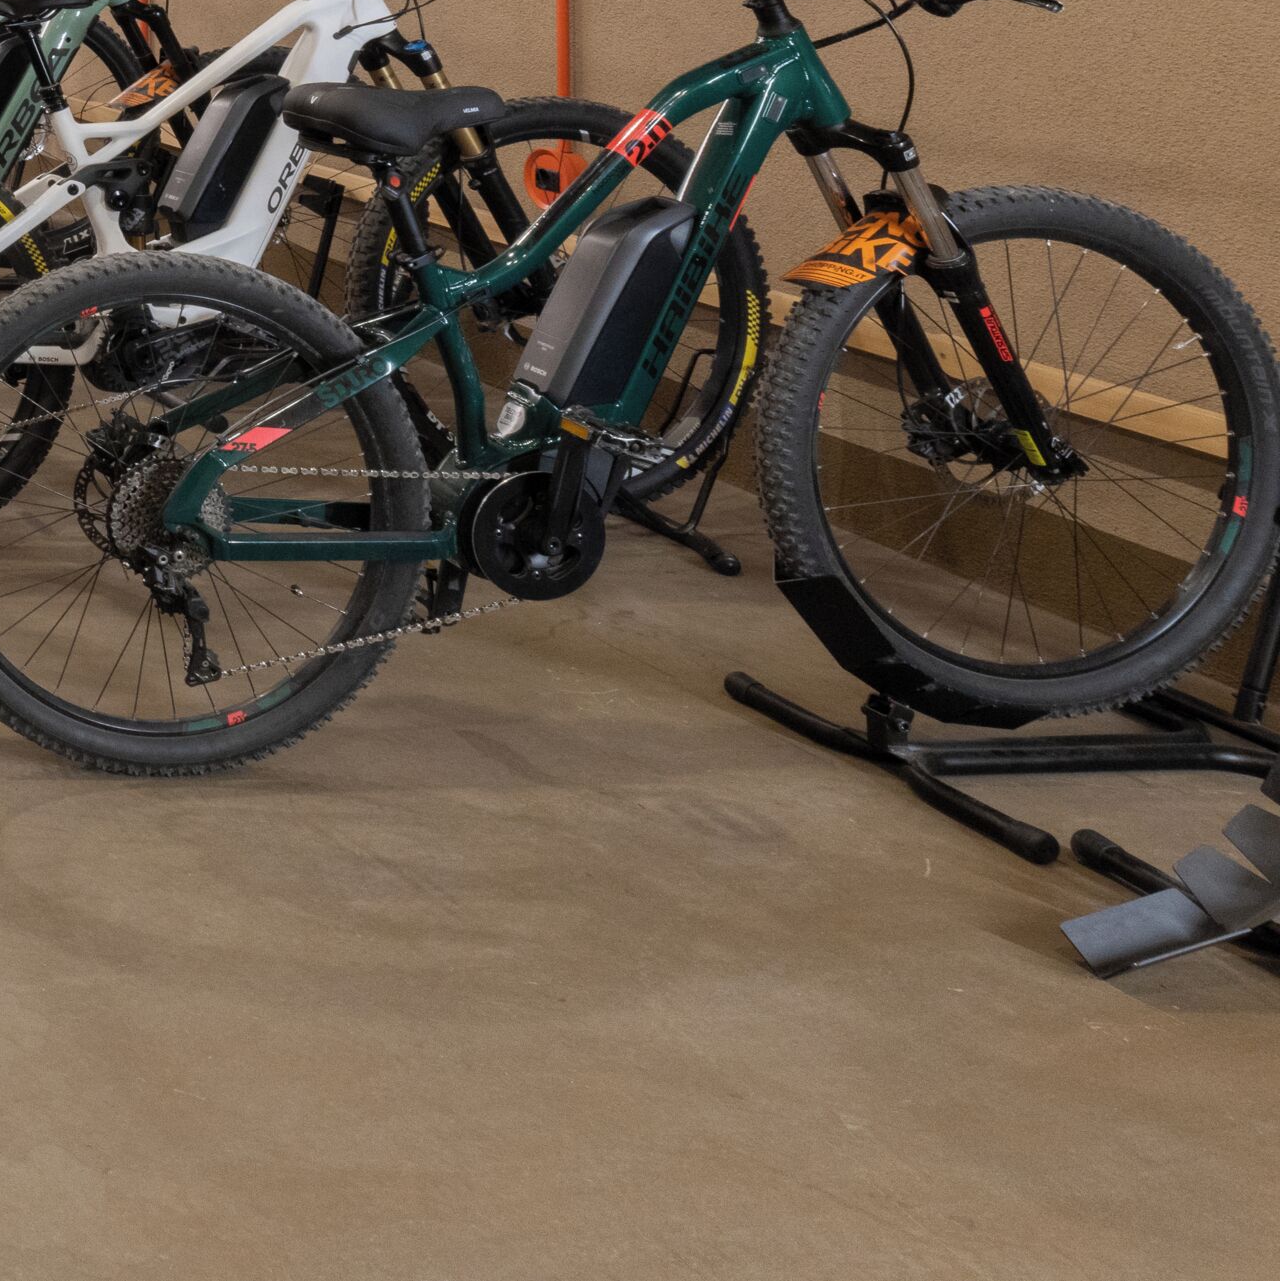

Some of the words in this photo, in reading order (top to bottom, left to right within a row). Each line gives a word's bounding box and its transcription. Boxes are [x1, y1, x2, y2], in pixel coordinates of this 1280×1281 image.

[643, 175, 749, 379] HAIBIKE
[38, 355, 59, 363] BOSCH
[695, 406, 734, 455] MICHELIN
